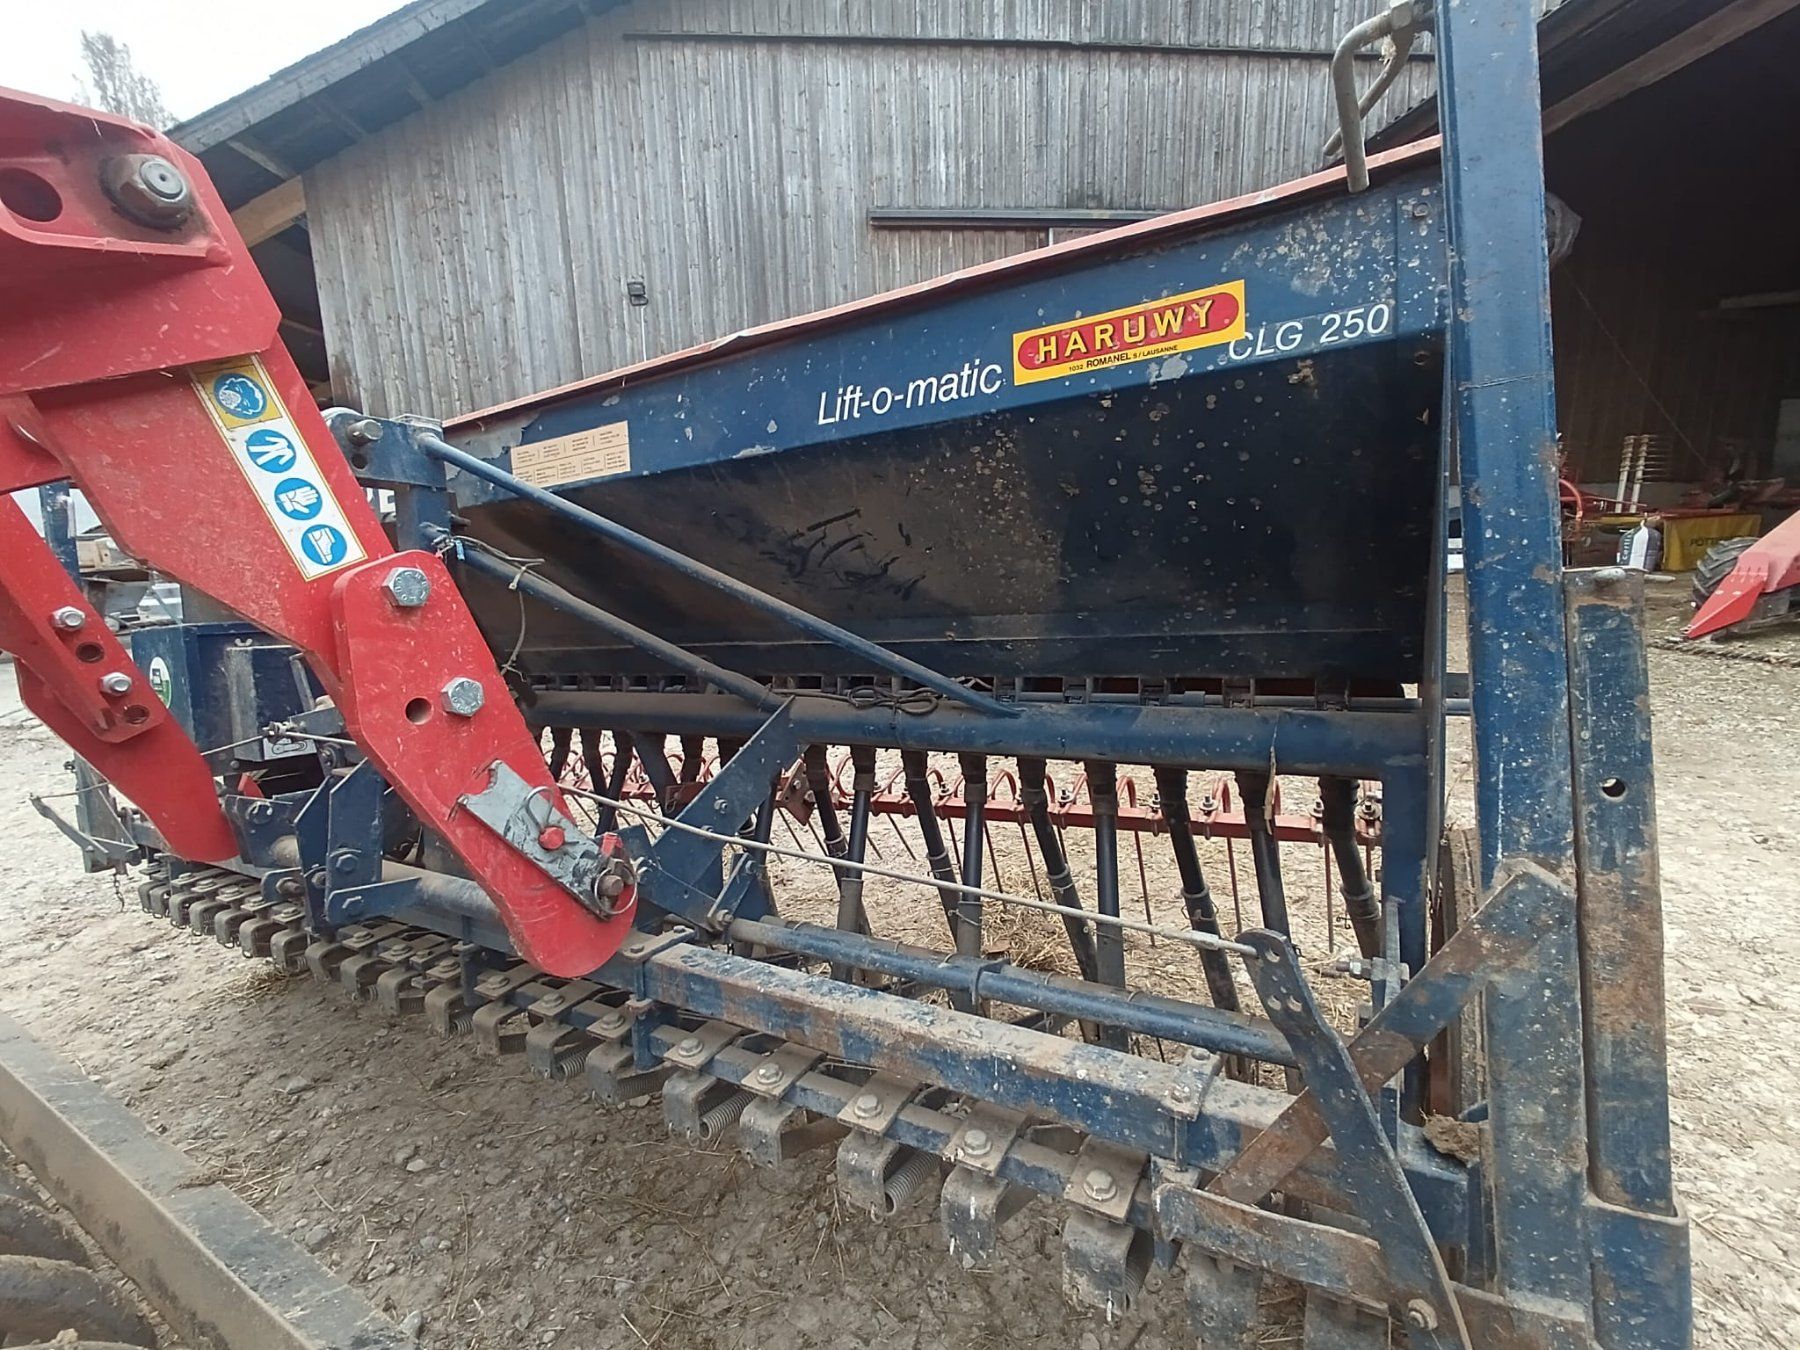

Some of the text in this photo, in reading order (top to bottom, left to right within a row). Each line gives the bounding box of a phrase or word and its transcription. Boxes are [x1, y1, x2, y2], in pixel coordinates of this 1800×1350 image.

[1038, 299, 1214, 363] HARUWY
[1086, 353, 1131, 369] ROMANEL
[1228, 303, 1389, 360] CLG 250
[817, 358, 1002, 425] Lift-o-matic
